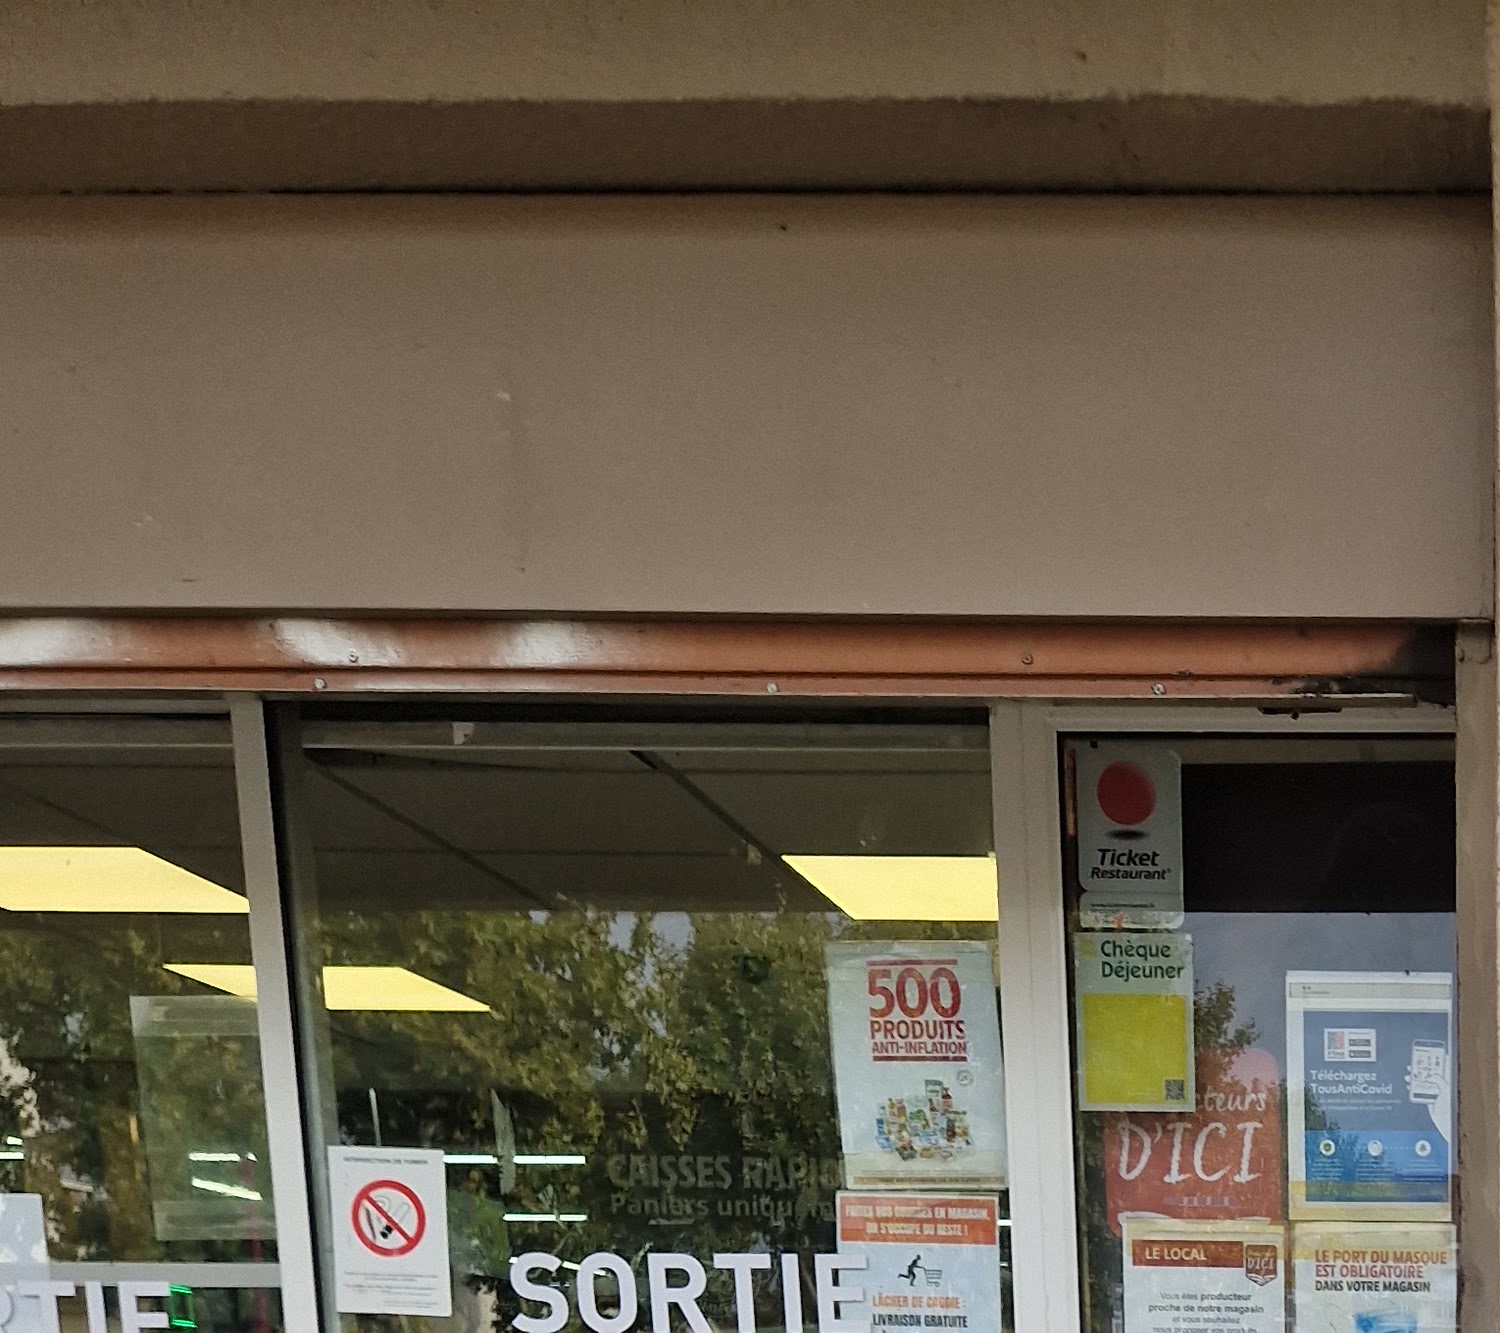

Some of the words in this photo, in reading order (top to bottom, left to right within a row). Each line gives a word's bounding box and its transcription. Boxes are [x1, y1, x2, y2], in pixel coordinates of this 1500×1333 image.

[1097, 848, 1160, 866] Ticket
[1100, 940, 1171, 961] Chèque
[1101, 961, 1185, 982] Déjeuner
[867, 967, 961, 1018] 500
[870, 1020, 966, 1039] PRODUITS
[872, 1041, 968, 1055] ANTI-INFLATION
[1309, 1070, 1377, 1084] Téléchargez
[1310, 1083, 1393, 1095] TousAntiCovid
[1117, 1121, 1264, 1184] D'ICI
[1145, 1247, 1160, 1260] LE
[1164, 1247, 1208, 1261] LOCAL
[1315, 1250, 1329, 1263] LE
[1333, 1250, 1367, 1263] PORT
[1370, 1250, 1389, 1264] DU
[1393, 1251, 1448, 1265] MASQUE
[1315, 1264, 1336, 1278] EST
[1340, 1265, 1424, 1279] OBLIGATOIRE
[1315, 1280, 1344, 1291] DANS
[1346, 1280, 1380, 1292] VOTRE
[1382, 1280, 1431, 1293] MAGASIN
[872, 1313, 921, 1327] LIVRAISON
[924, 1315, 968, 1328] GRATUITE
